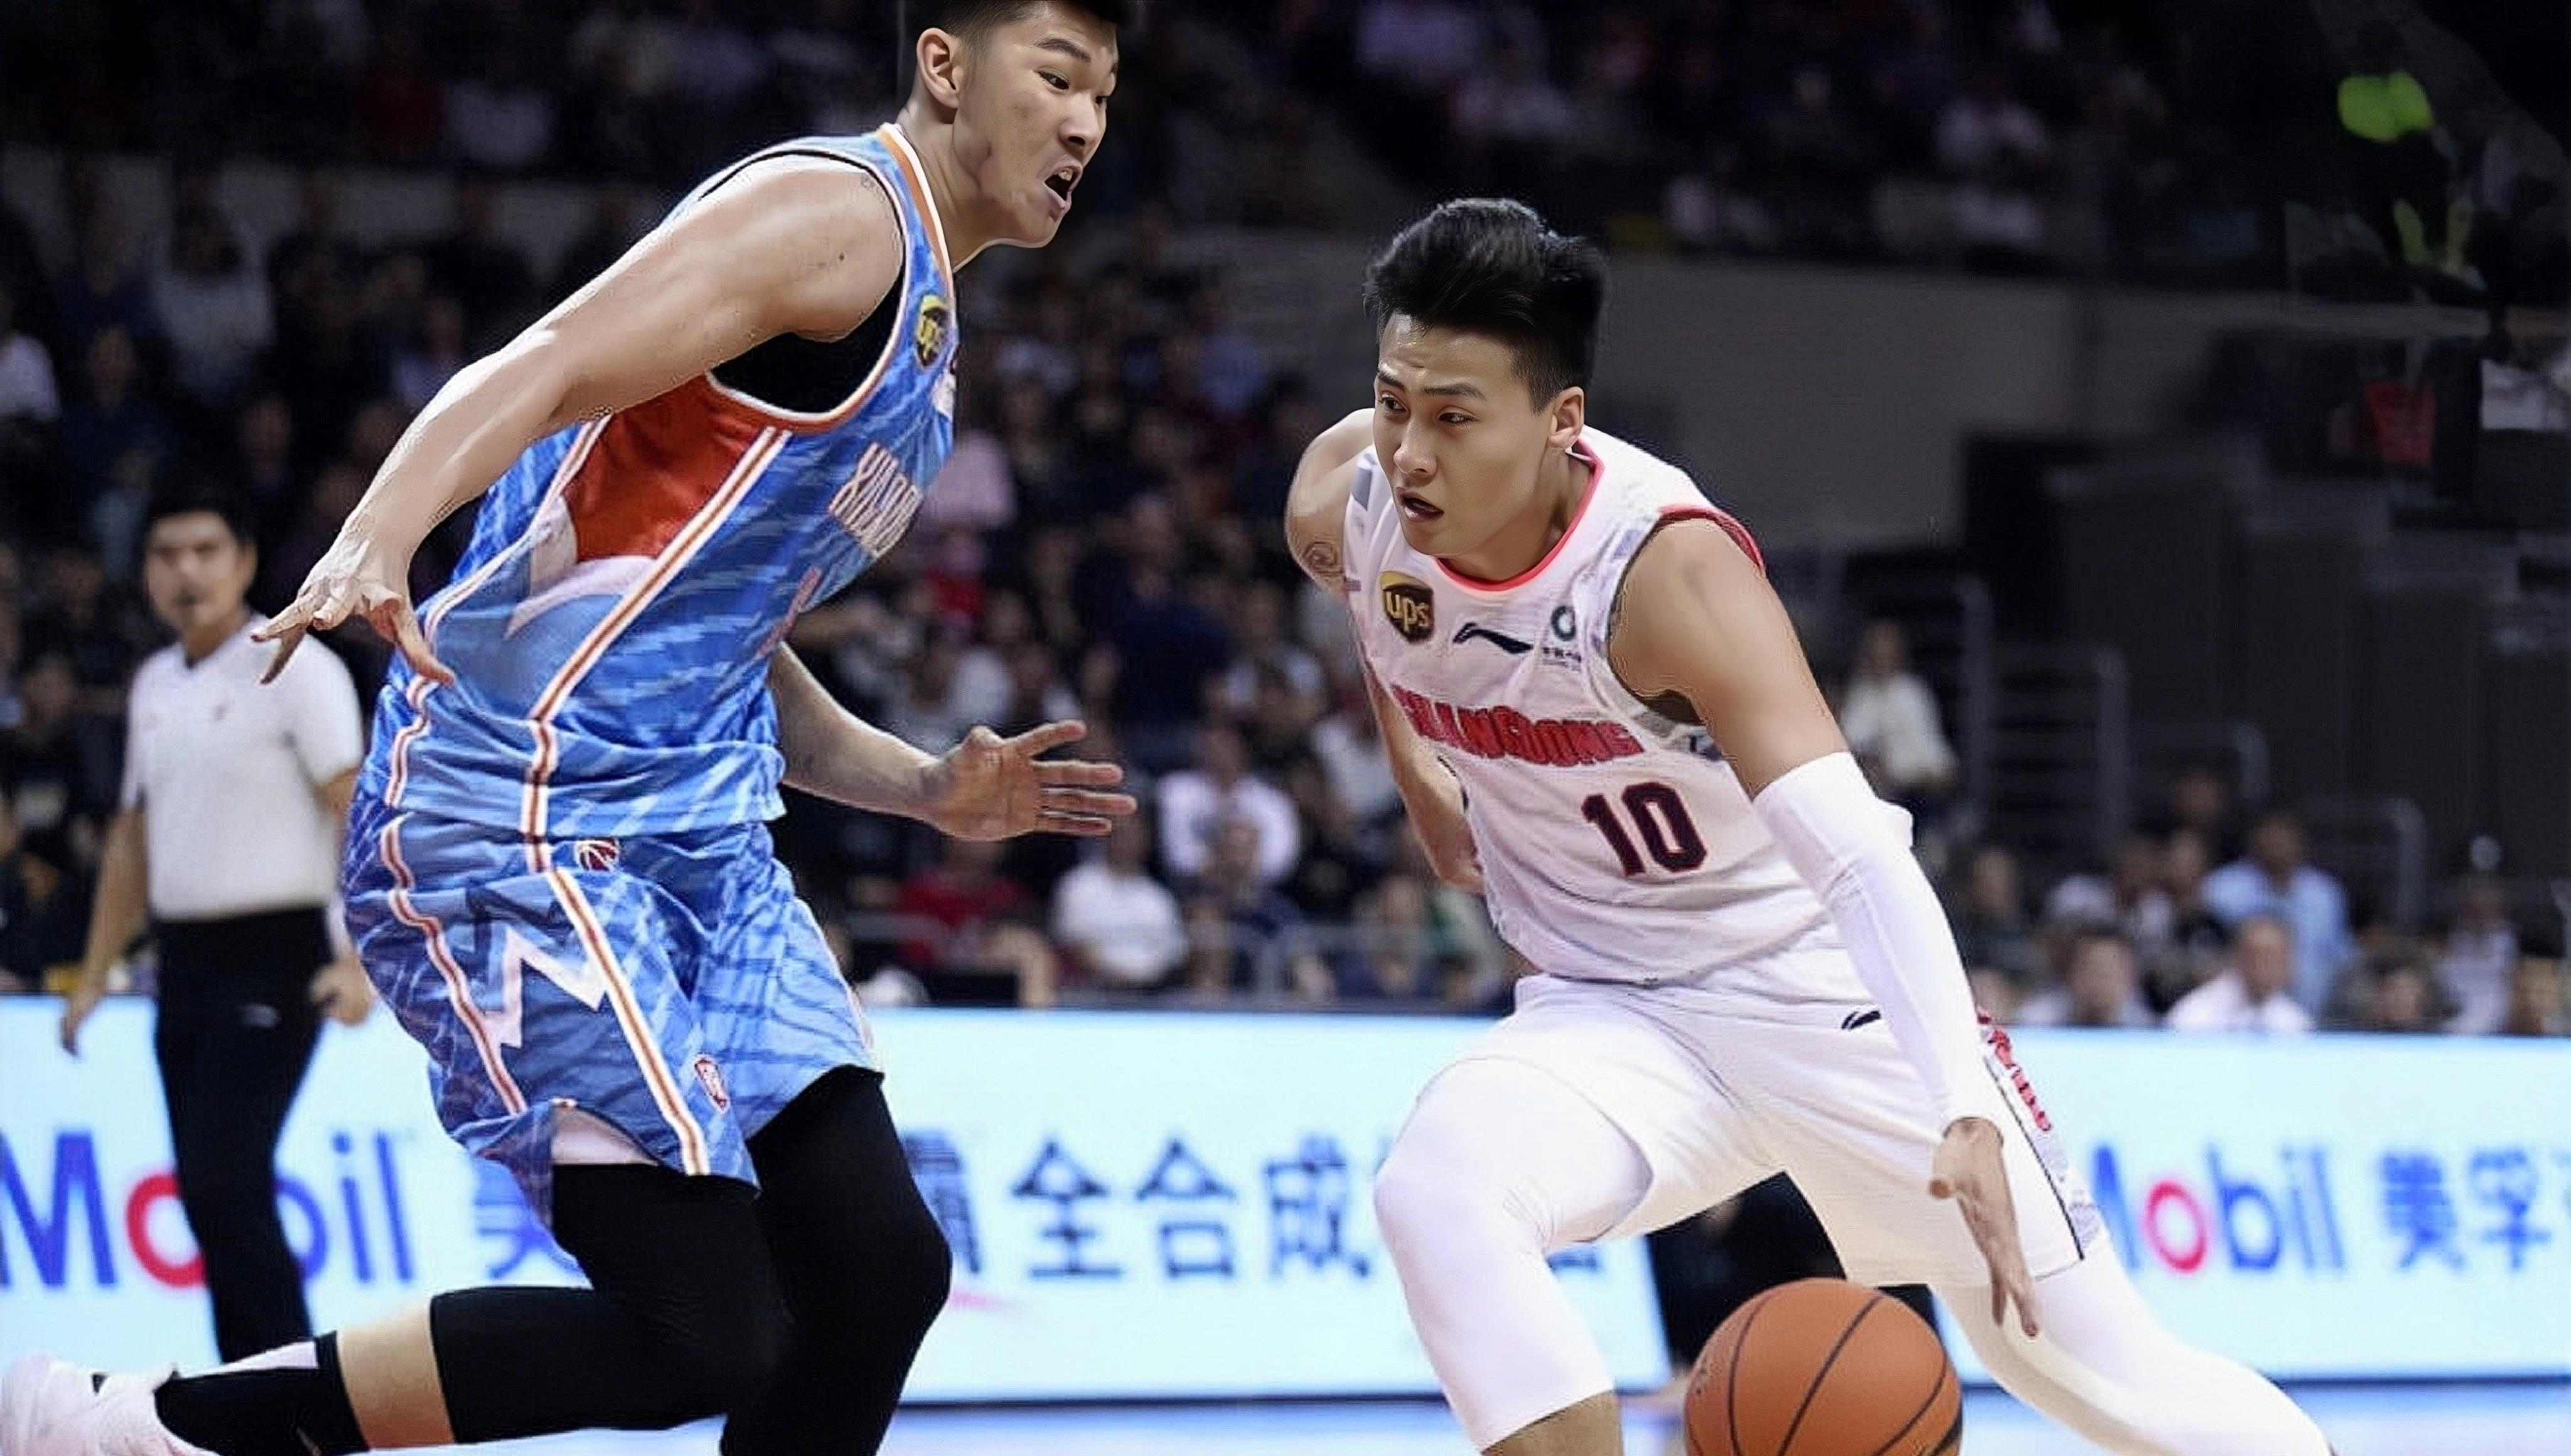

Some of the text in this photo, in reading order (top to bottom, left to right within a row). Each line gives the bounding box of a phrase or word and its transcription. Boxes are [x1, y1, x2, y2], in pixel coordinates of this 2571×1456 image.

[1384, 590, 1431, 633] ups
[1581, 781, 1707, 877] 10
[2378, 1147, 2571, 1273] 美孚
